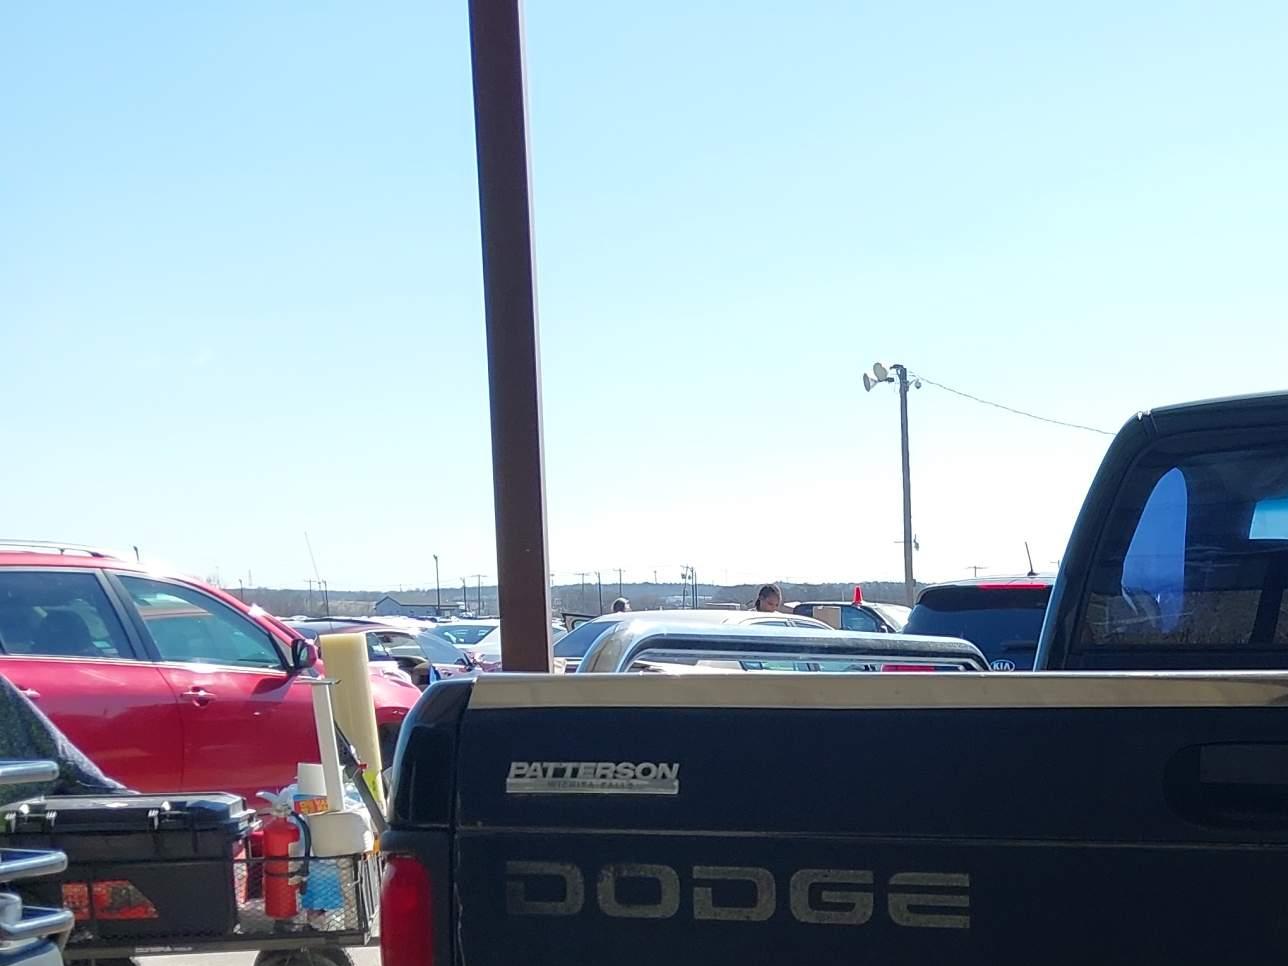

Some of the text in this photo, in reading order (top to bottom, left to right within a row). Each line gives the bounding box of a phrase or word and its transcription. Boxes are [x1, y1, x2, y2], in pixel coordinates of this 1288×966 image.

[992, 661, 1011, 671] KIA
[508, 761, 680, 781] PATTERSON
[505, 860, 971, 929] DODGE
